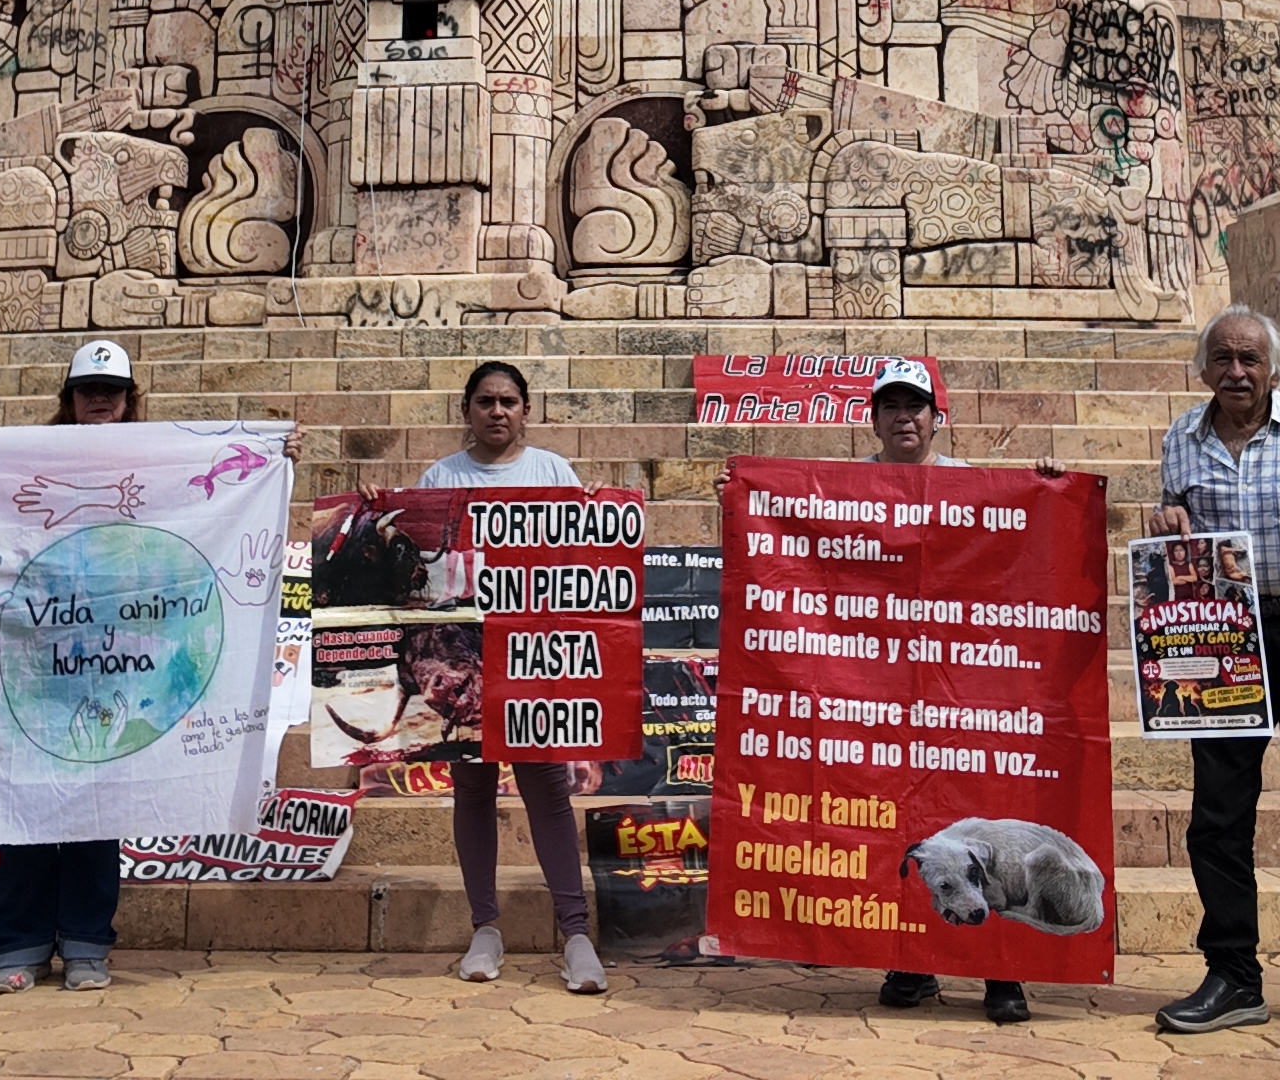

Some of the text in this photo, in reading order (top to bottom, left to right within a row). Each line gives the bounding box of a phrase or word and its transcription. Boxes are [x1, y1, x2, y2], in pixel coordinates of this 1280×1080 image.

[724, 354, 768, 377] La
[734, 392, 802, 422] Arte
[807, 393, 837, 422] Ni
[470, 503, 643, 546] TORTURADO
[748, 490, 1027, 532] Marchamos por los que
[747, 532, 904, 562] ya no están...
[25, 582, 214, 627] Vida animal
[477, 568, 633, 612] SIN PIEDAD
[745, 584, 1102, 634] Por los que fueron asesinados
[641, 604, 720, 622] MALTRATO
[1148, 601, 1244, 631] ¡JUSTICIA!
[1164, 622, 1230, 635] ENVENENAR A
[103, 624, 116, 652] y
[316, 646, 367, 663] Depende
[367, 645, 383, 660] de
[355, 628, 404, 644] cuando?
[744, 626, 1041, 669] cruelmente y sin razón...
[1150, 631, 1246, 649] PERROS Y GATOS
[1167, 645, 1231, 657] ES UN DELITO
[52, 642, 156, 675] humana
[509, 633, 600, 678] HASTA
[649, 693, 678, 707] Todo
[680, 694, 707, 706] acto
[741, 687, 1044, 735] Por la sangre derramada
[507, 701, 600, 746] MORIR
[739, 728, 1059, 778] de los que no tienen voz...
[280, 799, 349, 837] FORMA
[738, 783, 897, 829] Y por tanta
[183, 834, 332, 865] ANIMALES
[617, 817, 708, 855] ÉSTA
[735, 840, 868, 880] crueldad
[734, 886, 927, 933] en Yucatán...
